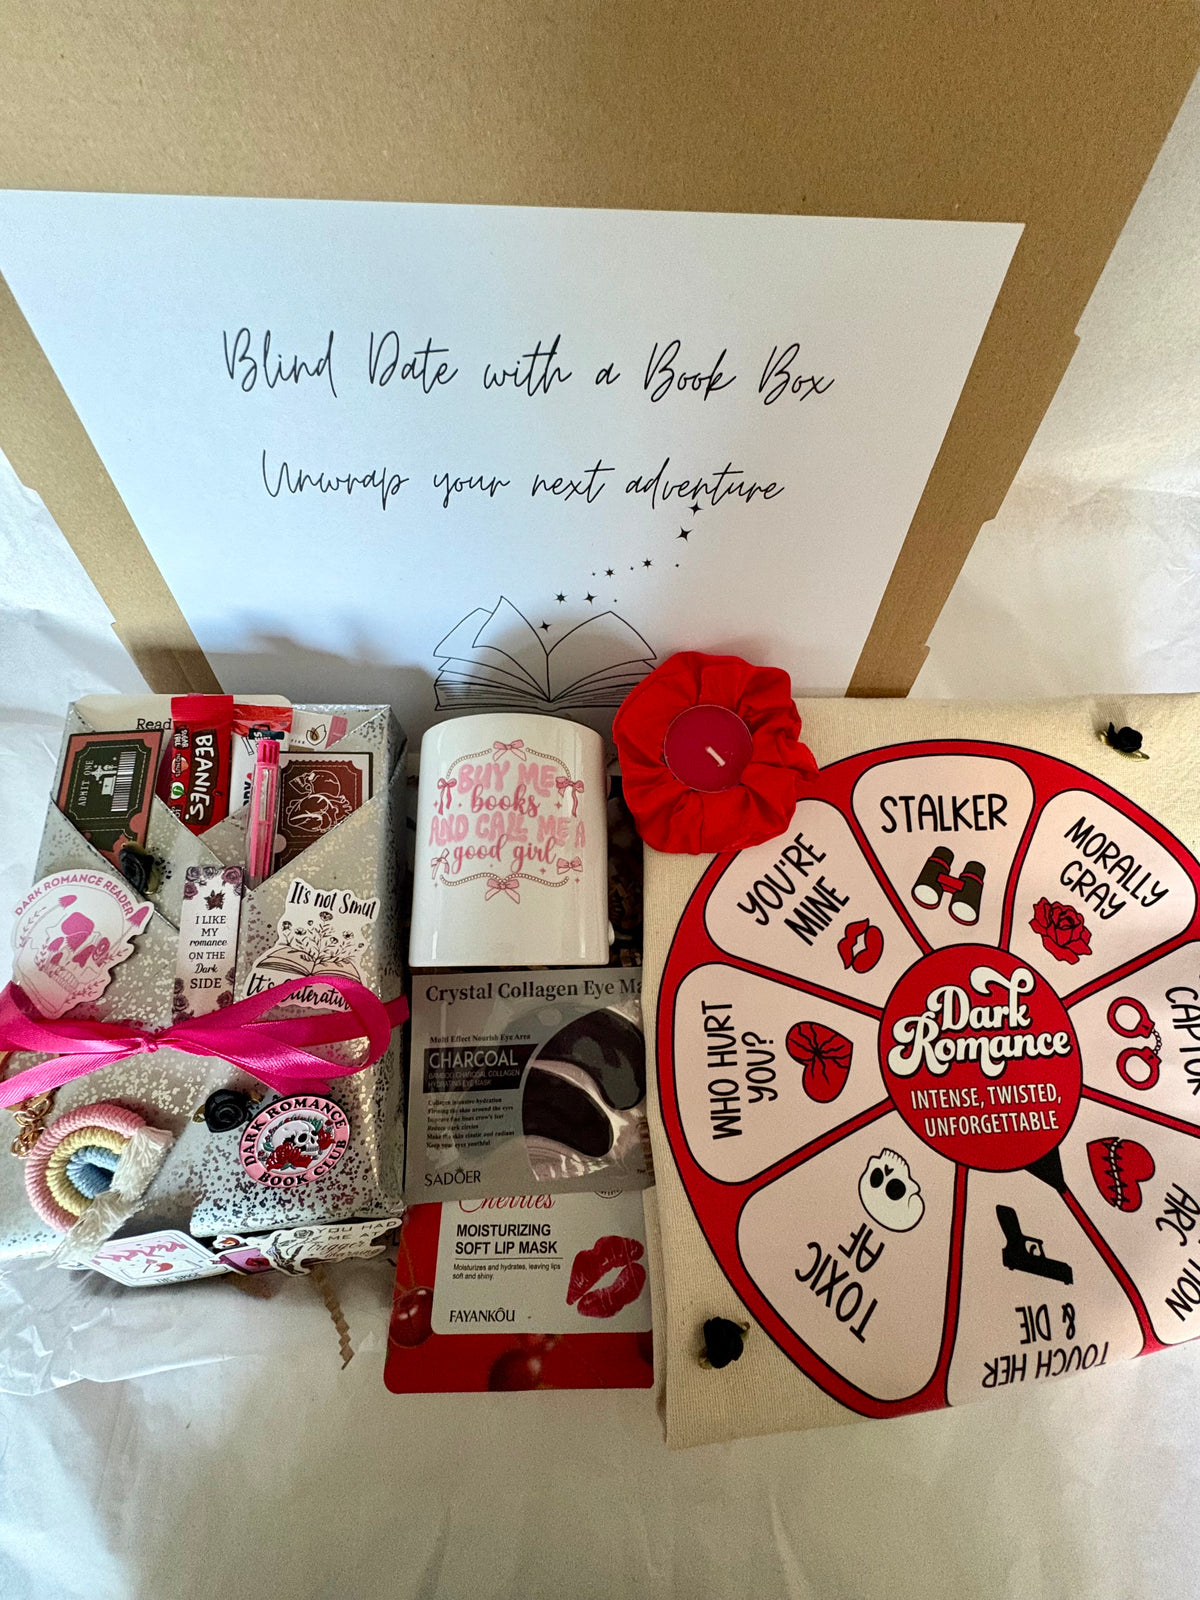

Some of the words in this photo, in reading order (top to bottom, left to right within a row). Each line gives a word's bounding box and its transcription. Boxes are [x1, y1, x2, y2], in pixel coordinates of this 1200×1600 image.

[223, 328, 337, 398] Blind
[369, 331, 458, 394] Date
[483, 334, 572, 396] with
[595, 363, 620, 385] a
[644, 340, 736, 402] Book
[758, 343, 835, 405] Box
[262, 449, 409, 510] Unwrap
[433, 473, 510, 508] your
[531, 459, 615, 503] next
[625, 457, 784, 509] adventure
[136, 718, 172, 730] Read
[83, 760, 94, 776] ONE
[457, 761, 510, 794] BUY
[518, 763, 557, 797] ME
[78, 780, 90, 806] ADMIT
[471, 784, 540, 817] books
[429, 813, 469, 847] AND
[475, 811, 528, 843] CALL
[537, 815, 571, 846] ME
[574, 820, 586, 849] A
[880, 794, 1007, 833] STALKER
[452, 834, 508, 874] good
[511, 837, 556, 874] girl
[1064, 816, 1169, 907] MORALLY
[15, 888, 42, 916] DARK
[44, 874, 104, 891] ROMANCE
[103, 881, 135, 917] READER
[737, 833, 827, 926] YOU'RE
[1059, 861, 1127, 920] GRAY
[289, 881, 311, 905] It's
[314, 892, 337, 912] not
[339, 893, 377, 920] Smut
[784, 876, 850, 946] MINE
[195, 916, 199, 925] I
[202, 915, 226, 925] LIKE
[201, 928, 219, 937] MY
[188, 952, 204, 960] ON
[206, 952, 225, 960] THE
[189, 939, 228, 947] romance
[190, 978, 222, 989] SIDE
[194, 963, 218, 974] Dark
[425, 983, 493, 1005] Crystal
[498, 981, 578, 1001] Collagen
[584, 980, 614, 999] Eye
[927, 967, 1035, 1033] Dark
[451, 1035, 471, 1043] Effect
[473, 1034, 499, 1042] Nourish
[501, 1033, 514, 1042] Eye
[702, 1000, 738, 1068] HURT
[888, 1012, 1071, 1077] Romance
[429, 1049, 518, 1069] CHARCOAL
[488, 1069, 520, 1077] COLLAGEN
[741, 1031, 778, 1104] YOU?
[708, 1079, 742, 1140] WHO
[911, 1087, 985, 1110] INTENSE,
[987, 1083, 1062, 1106] TWISTED,
[243, 1119, 267, 1167] DARK
[266, 1097, 347, 1129] ROMANCE
[925, 1110, 1059, 1138] UNFORGETTABLE
[259, 1171, 309, 1187] BOOK
[314, 1140, 347, 1176] CLUB
[317, 1226, 353, 1234] YOU
[362, 1220, 397, 1230] HAD
[456, 1223, 551, 1237] MOISTURIZING
[1155, 1182, 1200, 1247] ARC
[455, 1241, 491, 1254] SOFT
[495, 1241, 515, 1254] LIP
[519, 1241, 558, 1254] MASK
[838, 1223, 885, 1273] AF
[453, 1263, 487, 1271] Moisturizes
[487, 1263, 499, 1271] and
[500, 1262, 528, 1272] hydrates,
[528, 1262, 550, 1272] leaving
[551, 1262, 561, 1272] lips
[465, 1272, 476, 1280] and
[477, 1272, 494, 1282] shiny.
[795, 1242, 878, 1343] TOXIC
[1015, 1304, 1052, 1345] DIE
[1062, 1303, 1076, 1340] &
[981, 1352, 1027, 1389] HER
[1034, 1341, 1109, 1379] TOUCH
